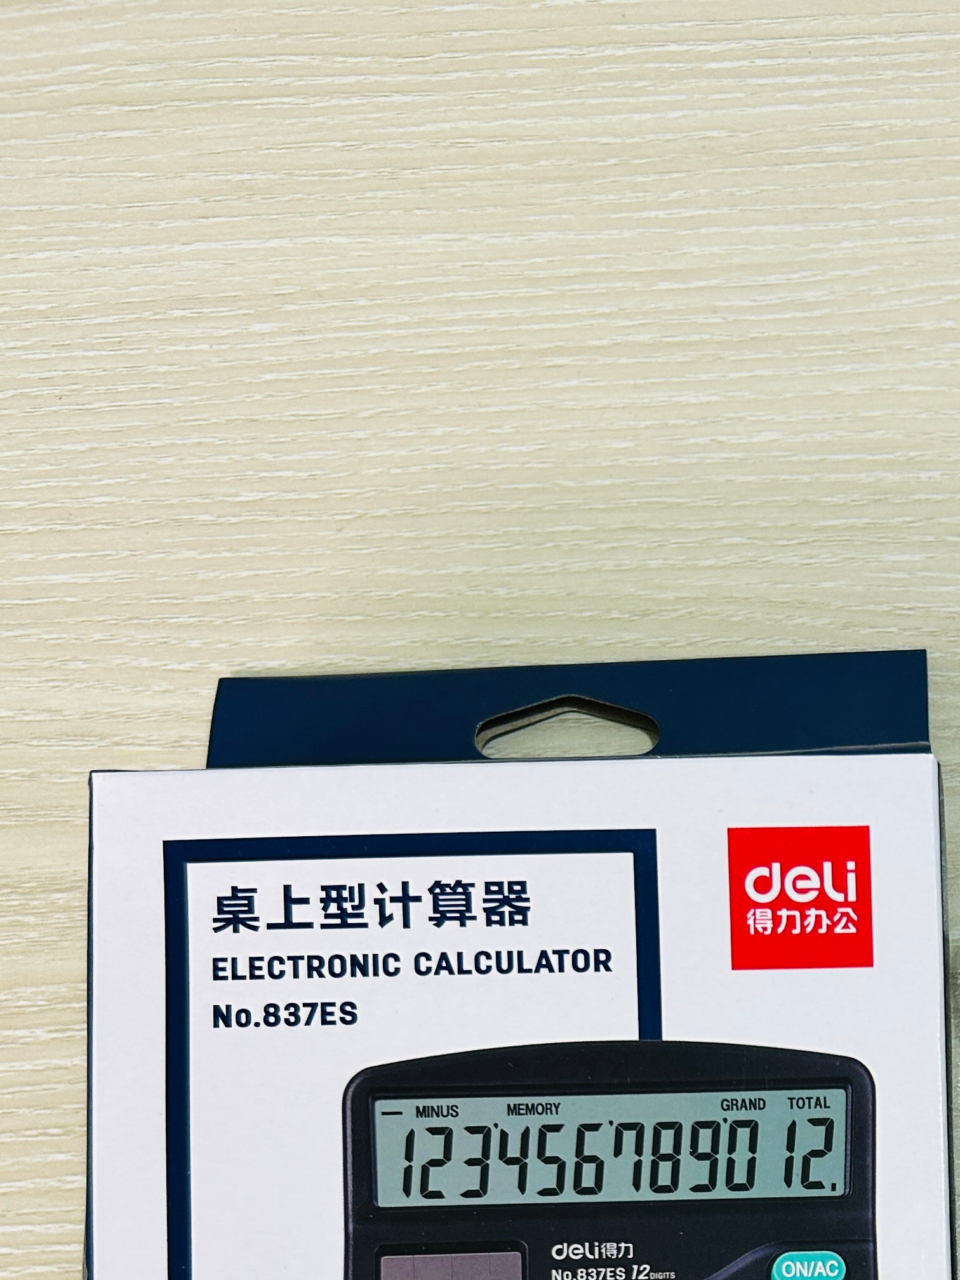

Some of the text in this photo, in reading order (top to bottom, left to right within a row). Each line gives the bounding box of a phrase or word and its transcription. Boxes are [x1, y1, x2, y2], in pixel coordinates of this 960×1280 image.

[744, 861, 857, 904] deli
[212, 879, 531, 934] 桌上型计算器
[746, 907, 858, 935] 得力办公
[212, 948, 613, 981] ELECTRONIC CALCULATOR
[212, 1001, 358, 1029] No.837ES
[415, 1104, 460, 1119] MINUS
[506, 1102, 561, 1117] MEMORY
[720, 1096, 831, 1112] GRAND TOTAL
[781, 1259, 840, 1279] ON/AC
